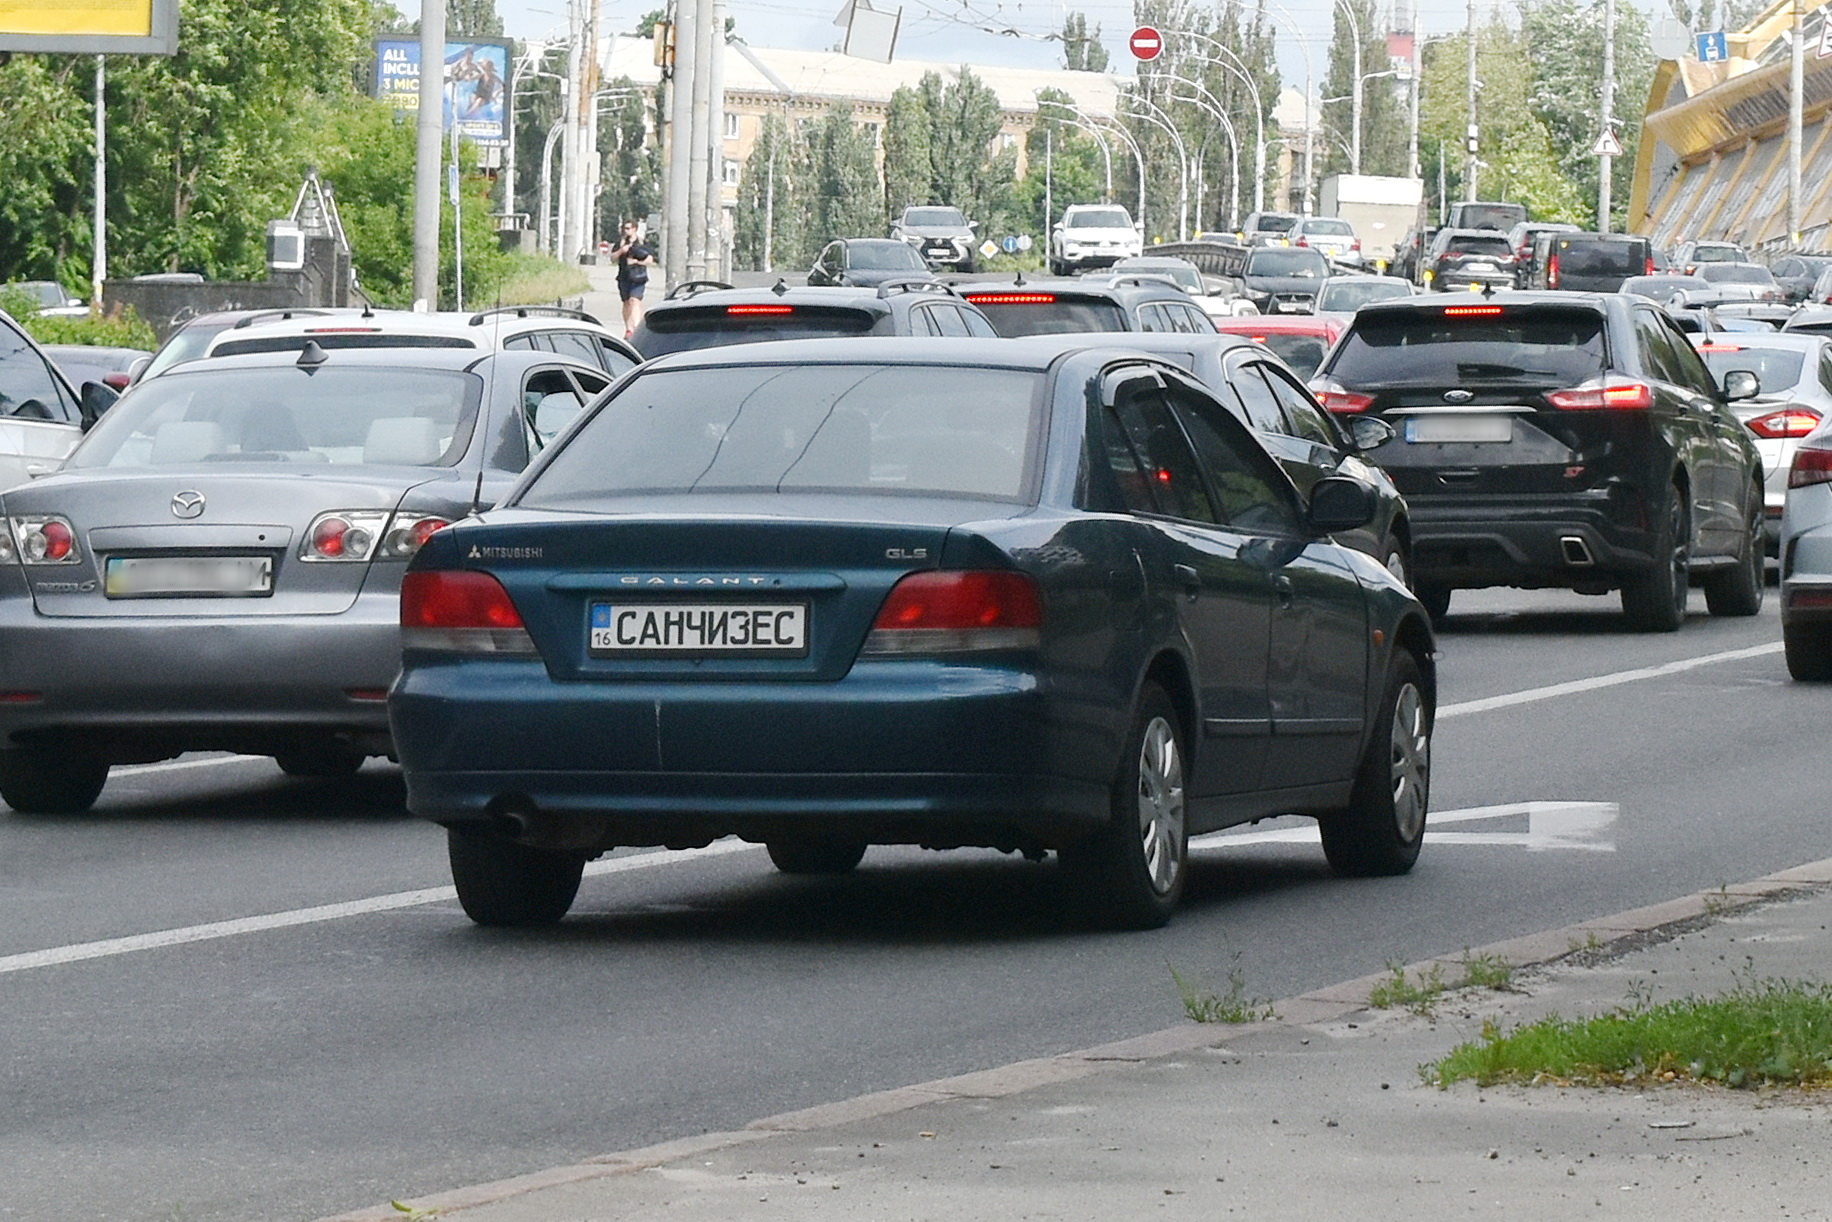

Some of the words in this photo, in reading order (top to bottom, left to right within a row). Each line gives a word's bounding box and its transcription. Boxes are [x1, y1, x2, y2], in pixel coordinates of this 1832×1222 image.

[383, 48, 407, 61] ALL
[383, 63, 452, 77] INCLUE
[383, 78, 391, 89] 3
[482, 546, 543, 558] MITSUBISHI
[885, 548, 927, 559] GLS
[620, 576, 765, 585] GALANT
[616, 610, 795, 646] САНЧИЗЕС
[594, 632, 611, 646] 16
